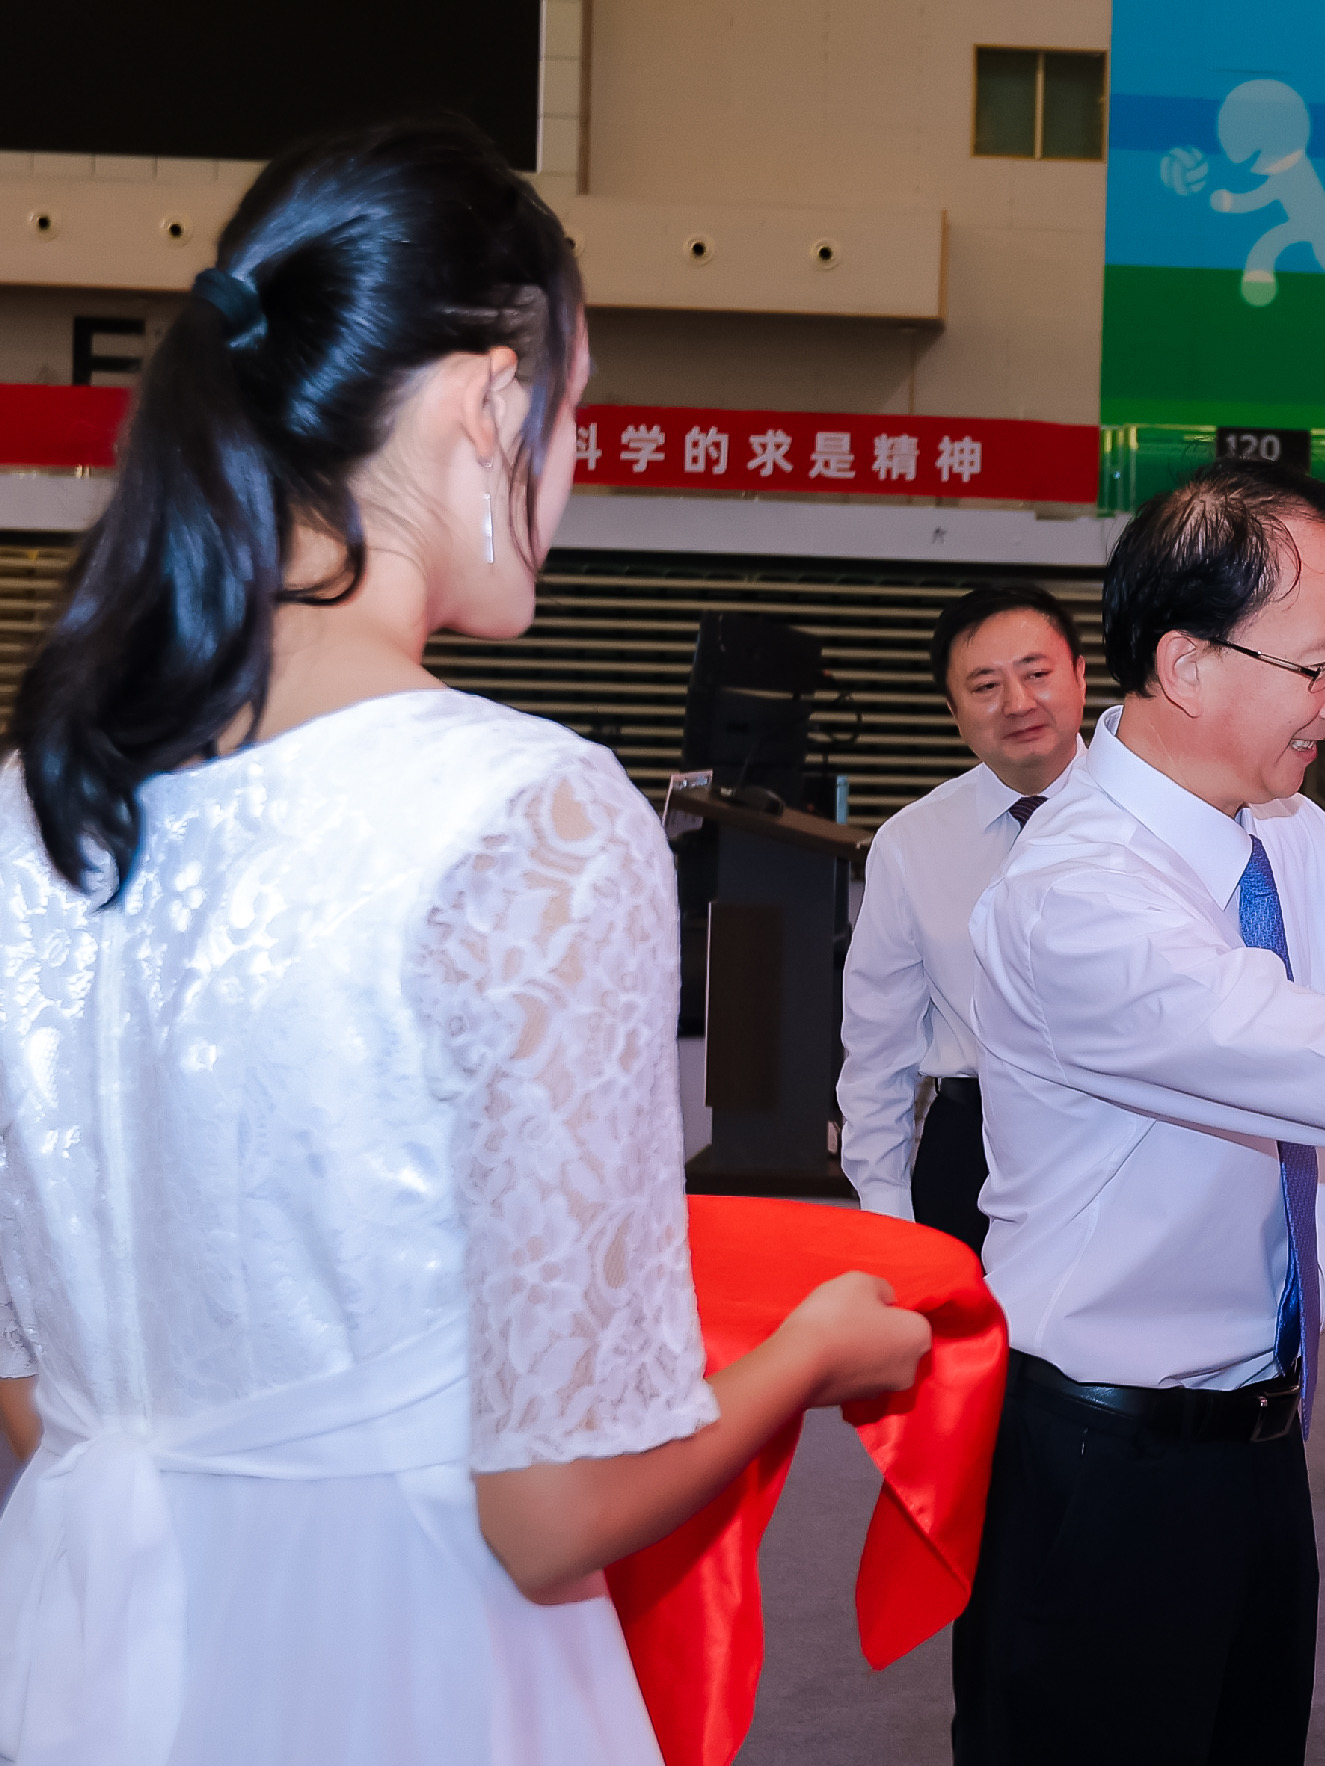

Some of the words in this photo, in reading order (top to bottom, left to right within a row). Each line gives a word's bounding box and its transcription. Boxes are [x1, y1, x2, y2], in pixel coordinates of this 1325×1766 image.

[576, 422, 983, 483] 科学的求是精神
[1226, 434, 1281, 462] 120
